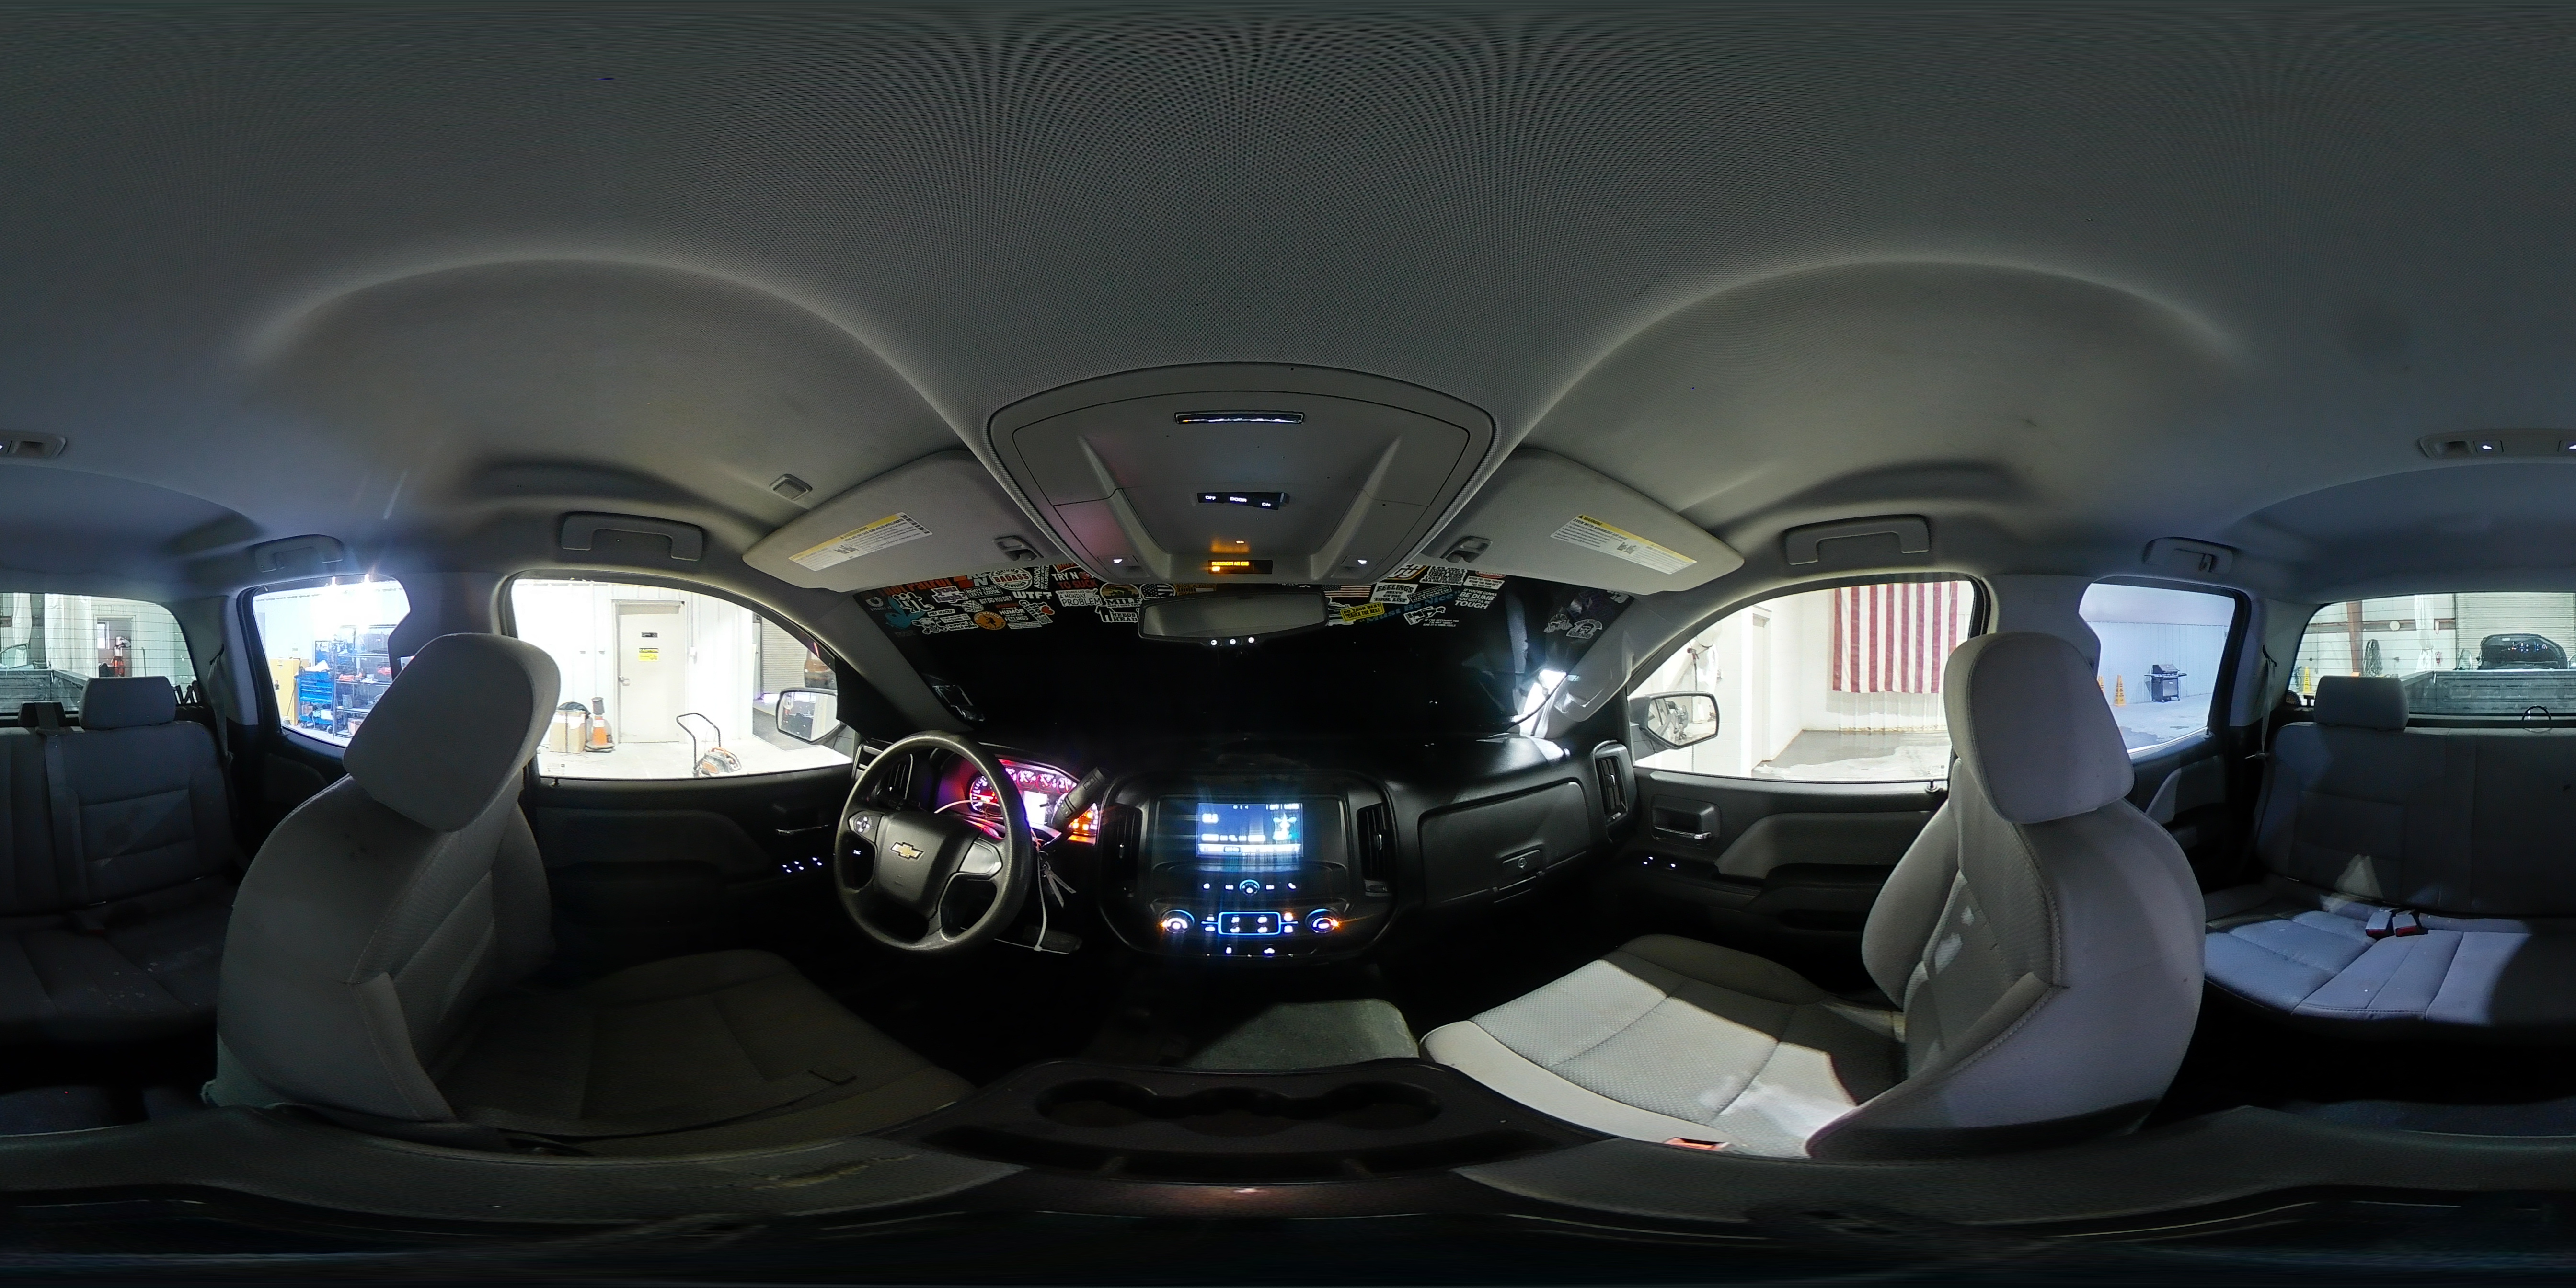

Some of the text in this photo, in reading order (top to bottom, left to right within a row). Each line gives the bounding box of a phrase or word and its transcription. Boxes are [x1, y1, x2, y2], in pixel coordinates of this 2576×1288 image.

[993, 573, 1029, 583] BADASS
[1051, 572, 1069, 581] TRY
[1057, 579, 1099, 589] TO SUCK
[1376, 584, 1414, 593] FEELINGS
[1012, 591, 1053, 599] WTF?
[1062, 598, 1101, 606] PROBLEM
[1454, 600, 1489, 610] TOUGH
[1404, 602, 1421, 612] Be
